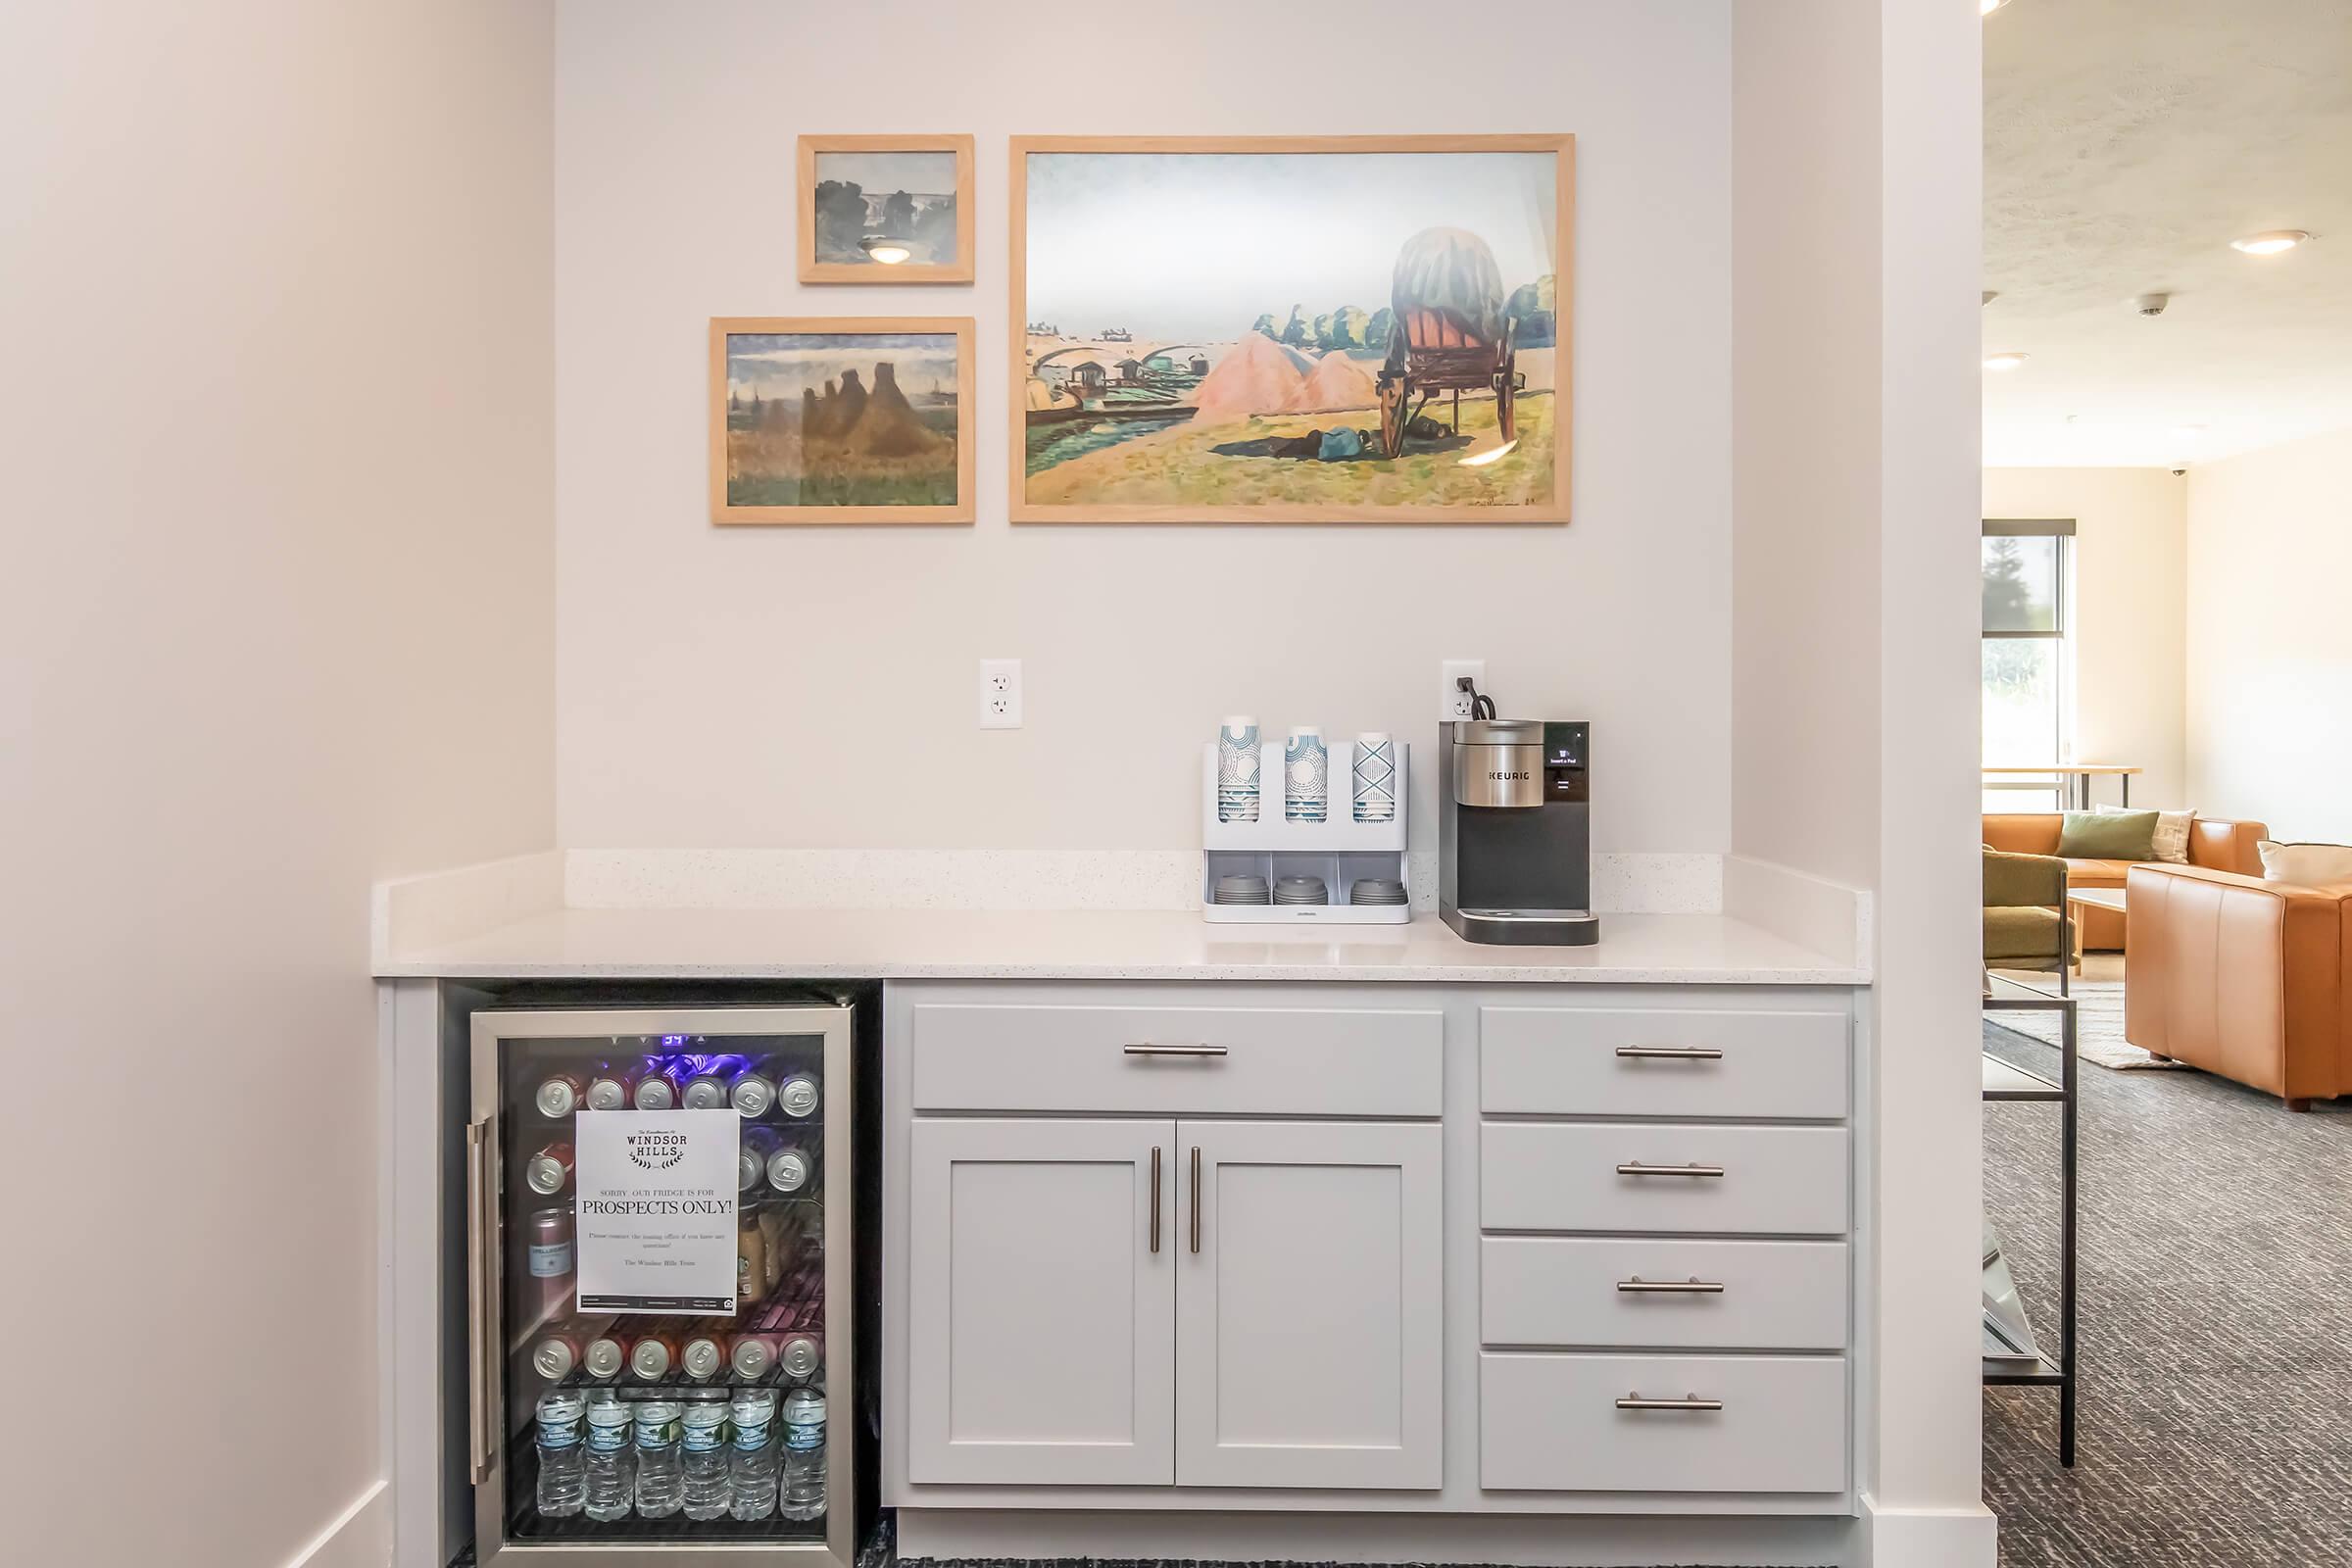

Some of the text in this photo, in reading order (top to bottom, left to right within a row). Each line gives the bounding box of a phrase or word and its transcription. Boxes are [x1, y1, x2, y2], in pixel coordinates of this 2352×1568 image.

[1489, 771, 1530, 780] KEURIG
[627, 1136, 687, 1146] WINDSOR
[637, 1147, 677, 1156] HILLS
[582, 1200, 732, 1215] PROSPECTS ONLY!
